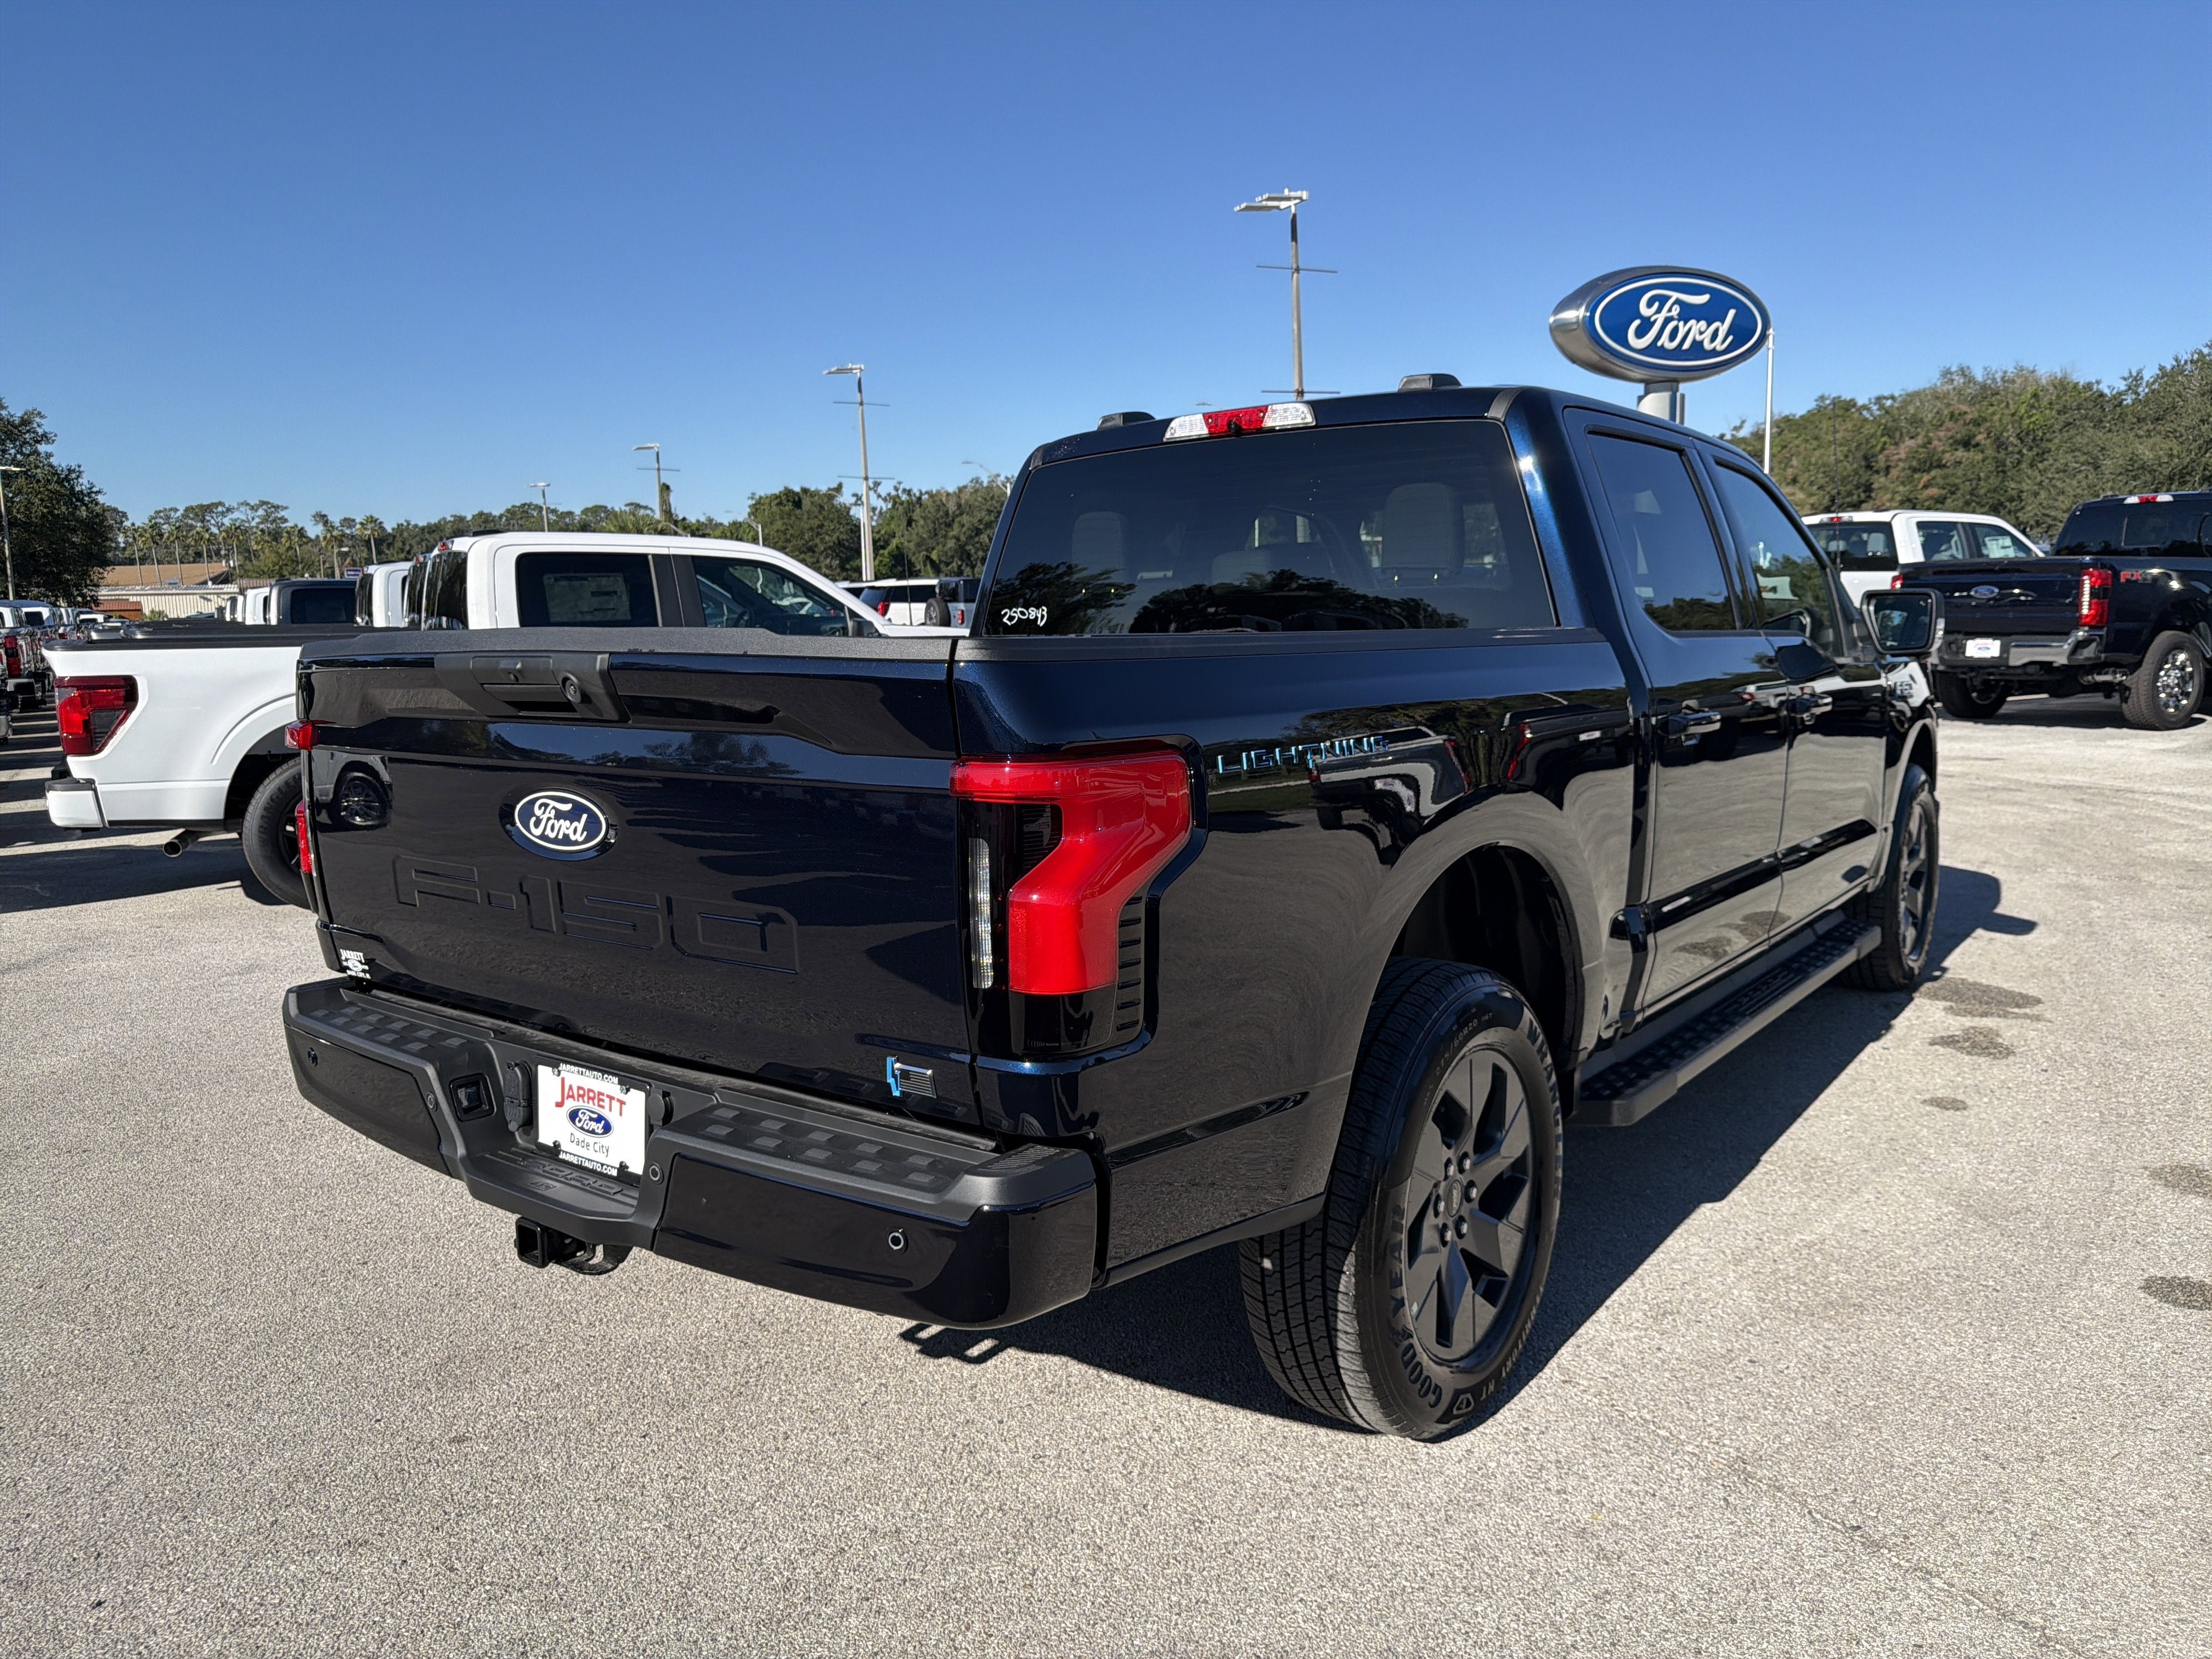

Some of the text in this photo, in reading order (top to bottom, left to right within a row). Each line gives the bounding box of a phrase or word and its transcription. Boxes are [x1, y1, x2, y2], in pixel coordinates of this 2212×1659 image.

[1627, 289, 1737, 352] Ford
[1001, 606, 1047, 627] 250843
[1217, 735, 1390, 774] LIGHTNING
[529, 798, 587, 842] Ford
[391, 854, 799, 974] F-150
[340, 949, 365, 963] JARRETT
[558, 1063, 619, 1085] JARRETTAUTO.COM
[555, 1076, 627, 1117] JARRETT
[1527, 1017, 1562, 1200] WRANGLER
[575, 1109, 605, 1134] Ford
[569, 1132, 610, 1158] Dade City
[558, 1151, 618, 1177] JARRETTAUTO.COM
